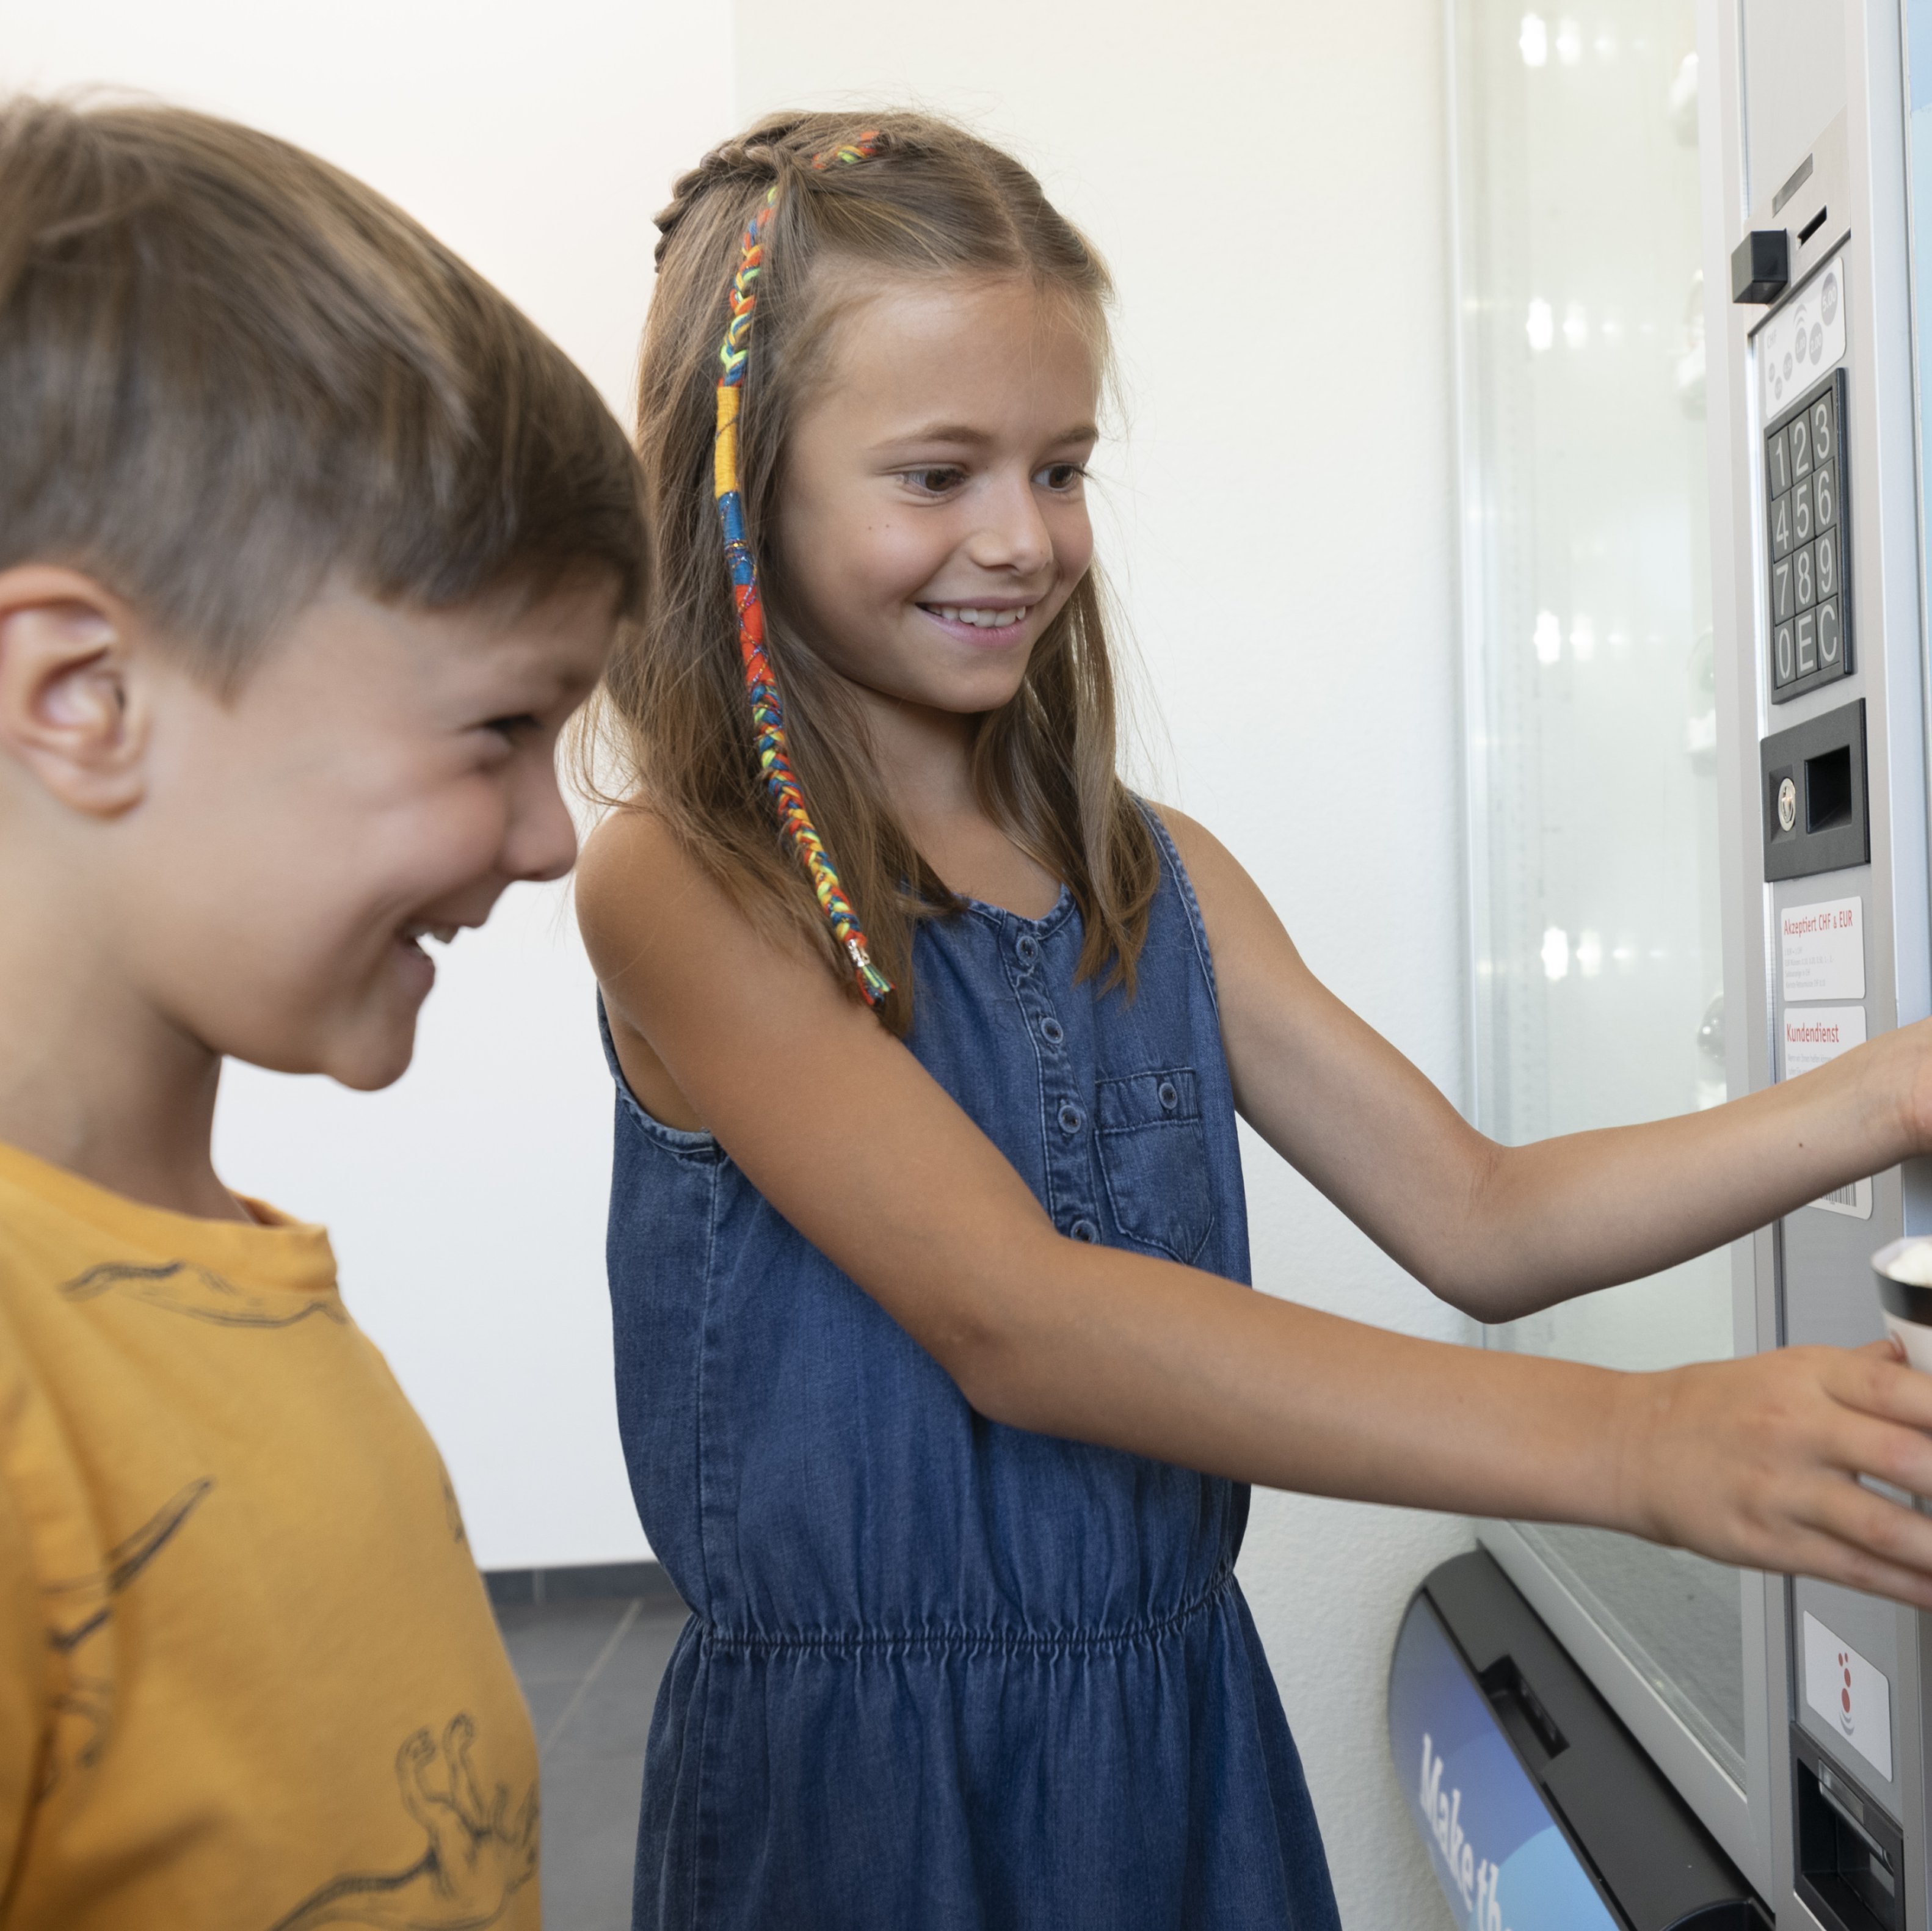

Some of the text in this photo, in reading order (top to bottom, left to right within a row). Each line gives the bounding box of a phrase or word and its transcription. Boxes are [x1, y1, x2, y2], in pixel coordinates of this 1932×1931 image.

[1822, 285, 1837, 312] 5.00
[1810, 333, 1822, 354] 2.00
[1775, 403, 1830, 487] 1 2 3
[1776, 470, 1832, 550] 4 5 6
[1776, 539, 1832, 616] 7 8 9
[1798, 615, 1814, 672] E
[1819, 604, 1838, 663] C
[1784, 910, 1853, 938] Akzeptiert CHF & EUR
[1787, 1022, 1839, 1042] Kundendienst
[1419, 1732, 1512, 1931] Make th
